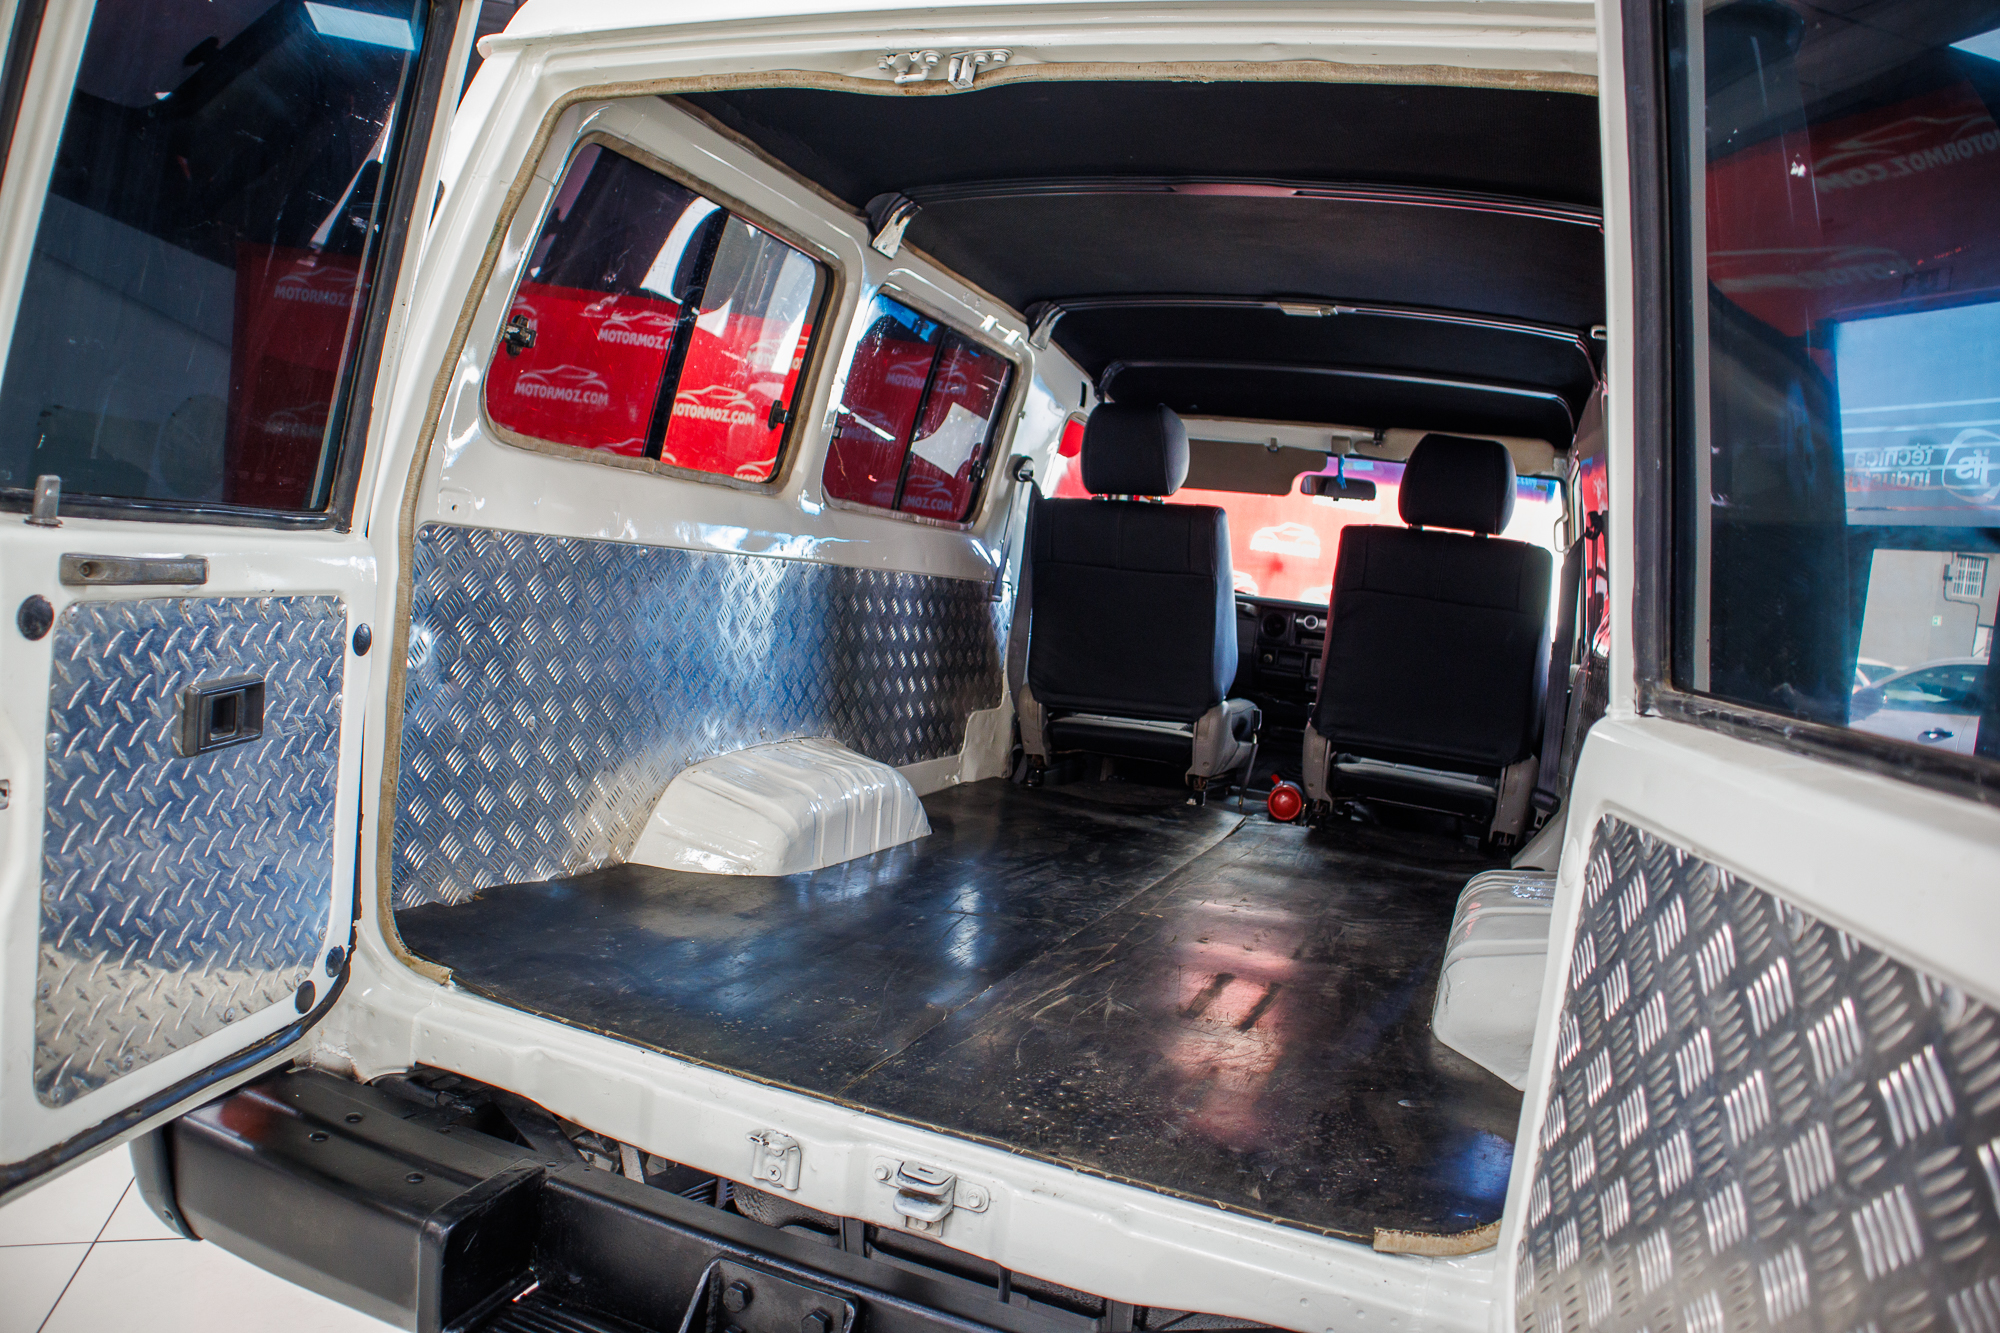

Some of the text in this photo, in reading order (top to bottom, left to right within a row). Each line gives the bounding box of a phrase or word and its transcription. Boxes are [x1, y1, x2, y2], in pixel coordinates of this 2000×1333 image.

[274, 284, 365, 308] MOTORMOZ.
[598, 328, 673, 351] MOTORMOZ.C
[514, 381, 610, 405] MOTORMOZ.COM
[885, 372, 968, 396] MOTORZ.COM
